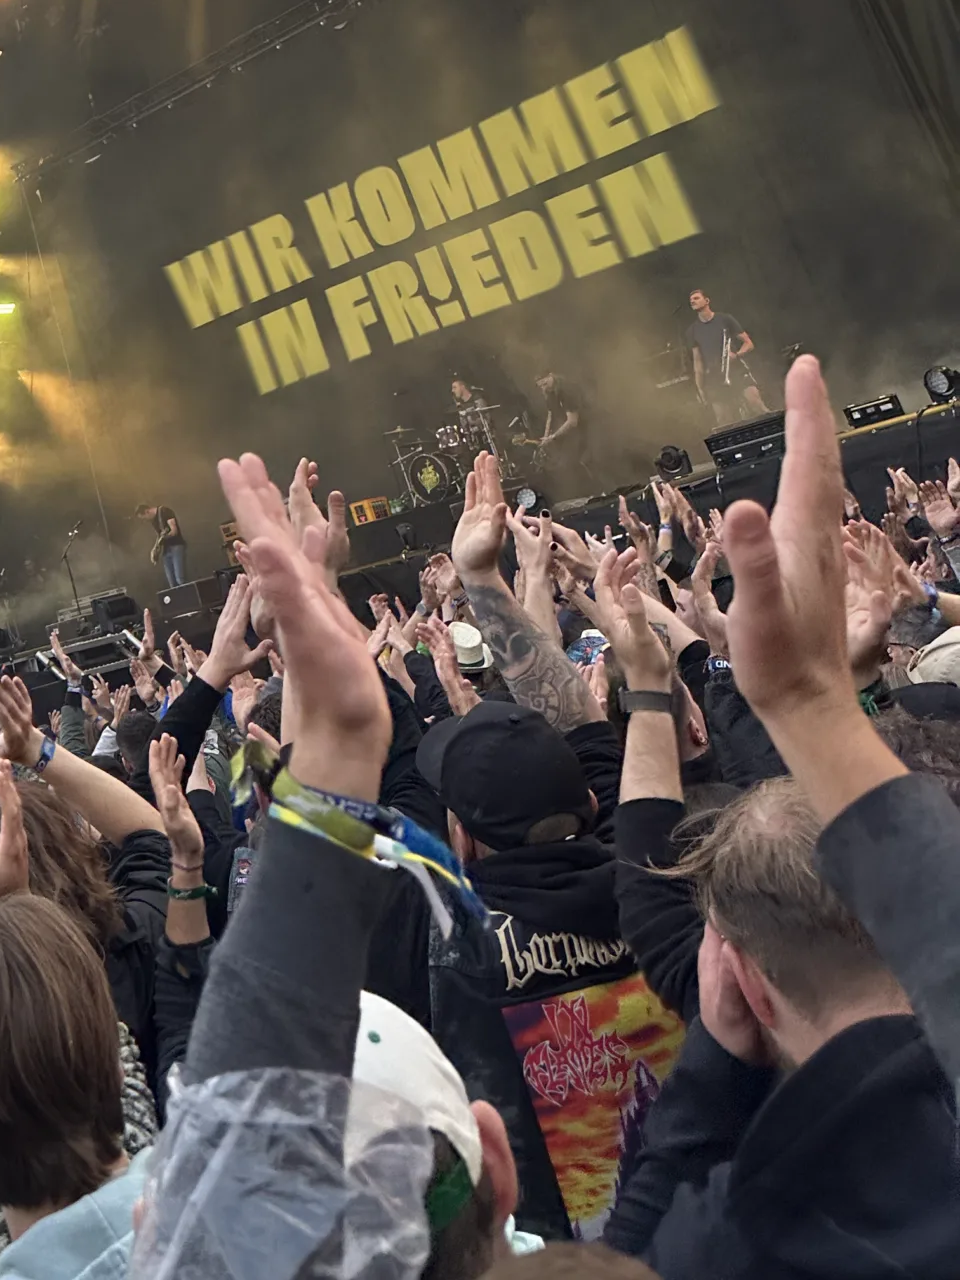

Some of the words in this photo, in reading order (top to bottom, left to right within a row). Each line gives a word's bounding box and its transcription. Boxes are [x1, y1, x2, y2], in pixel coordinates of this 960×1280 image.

[164, 213, 314, 328] WIR
[304, 24, 721, 269] KOMMEN
[236, 297, 329, 395] IN
